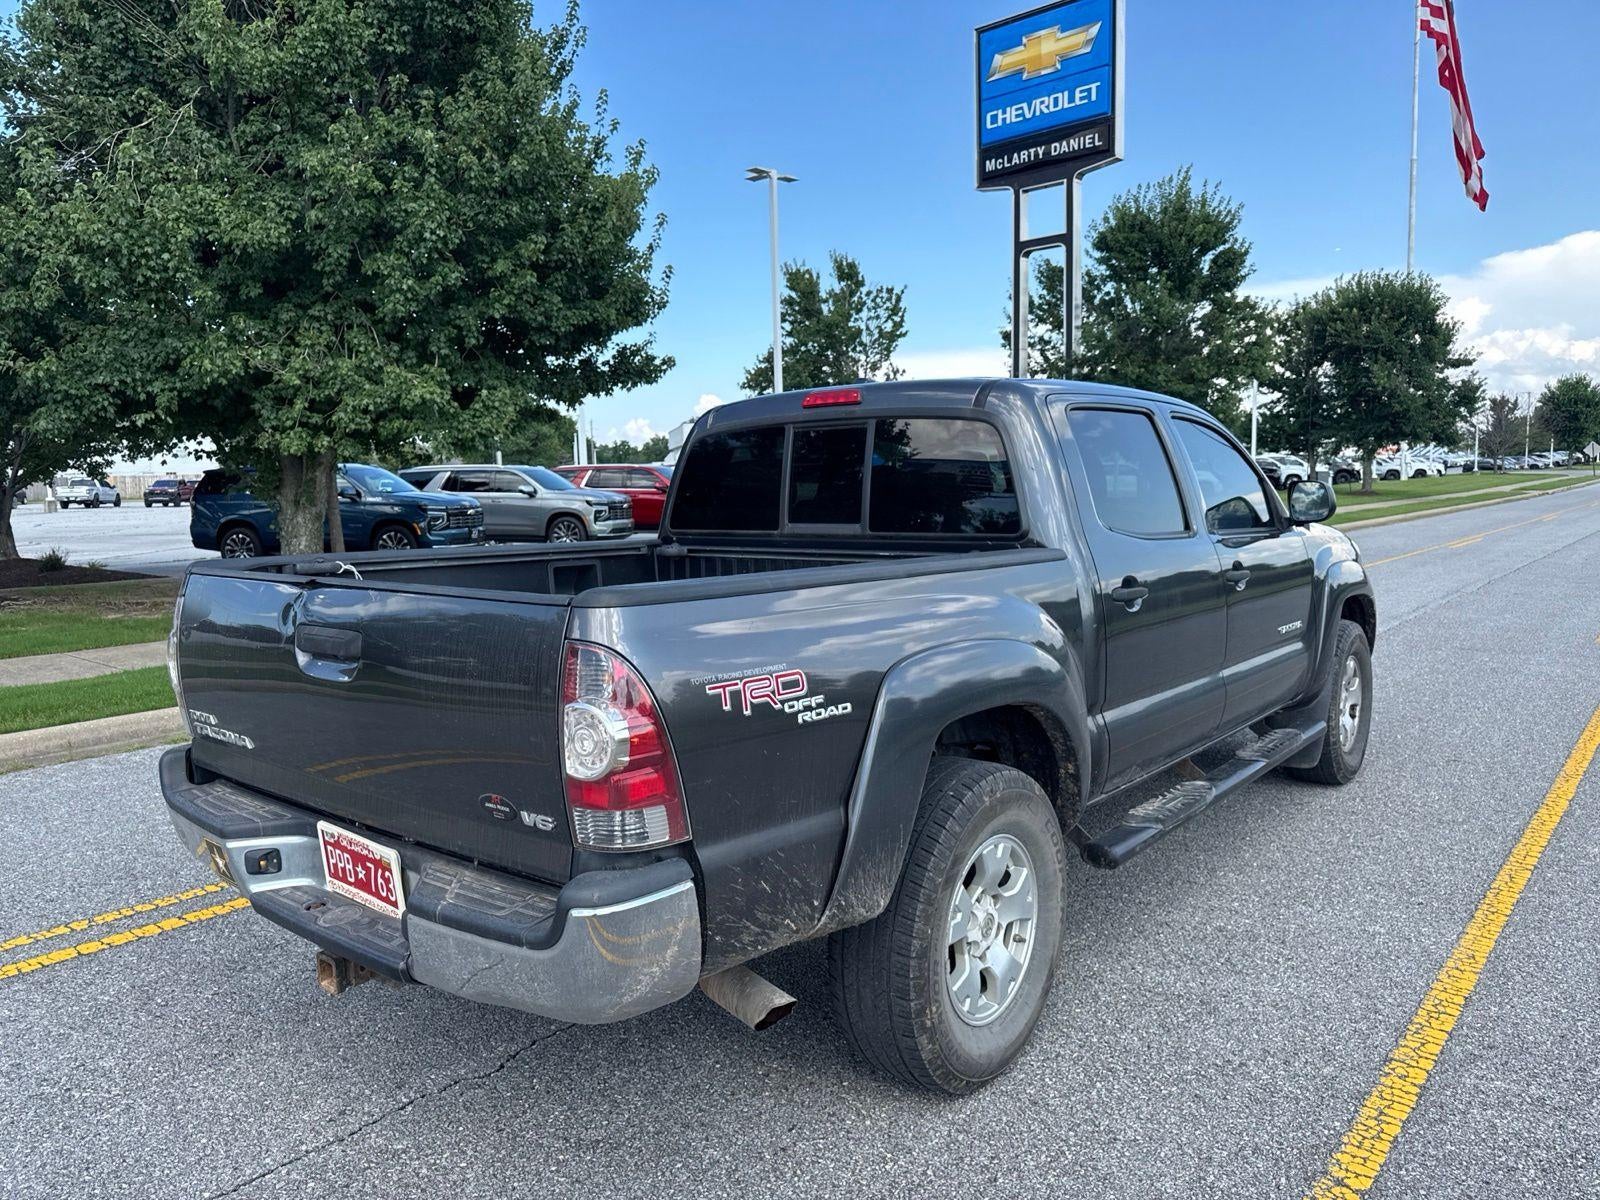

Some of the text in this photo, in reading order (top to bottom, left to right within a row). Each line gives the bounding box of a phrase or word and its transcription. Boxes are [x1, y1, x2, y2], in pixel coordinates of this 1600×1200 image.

[986, 82, 1101, 130] CHEVROLET
[985, 133, 1103, 172] McLARTY DANIEL
[691, 663, 787, 686] TOYOTA RACING DEVELOPMENT
[705, 669, 808, 716] TRD
[783, 695, 825, 713] OFF
[797, 702, 852, 724] ROAD
[193, 721, 255, 749] TACOMA
[520, 810, 556, 831] V6
[326, 845, 396, 902] PPB 763
